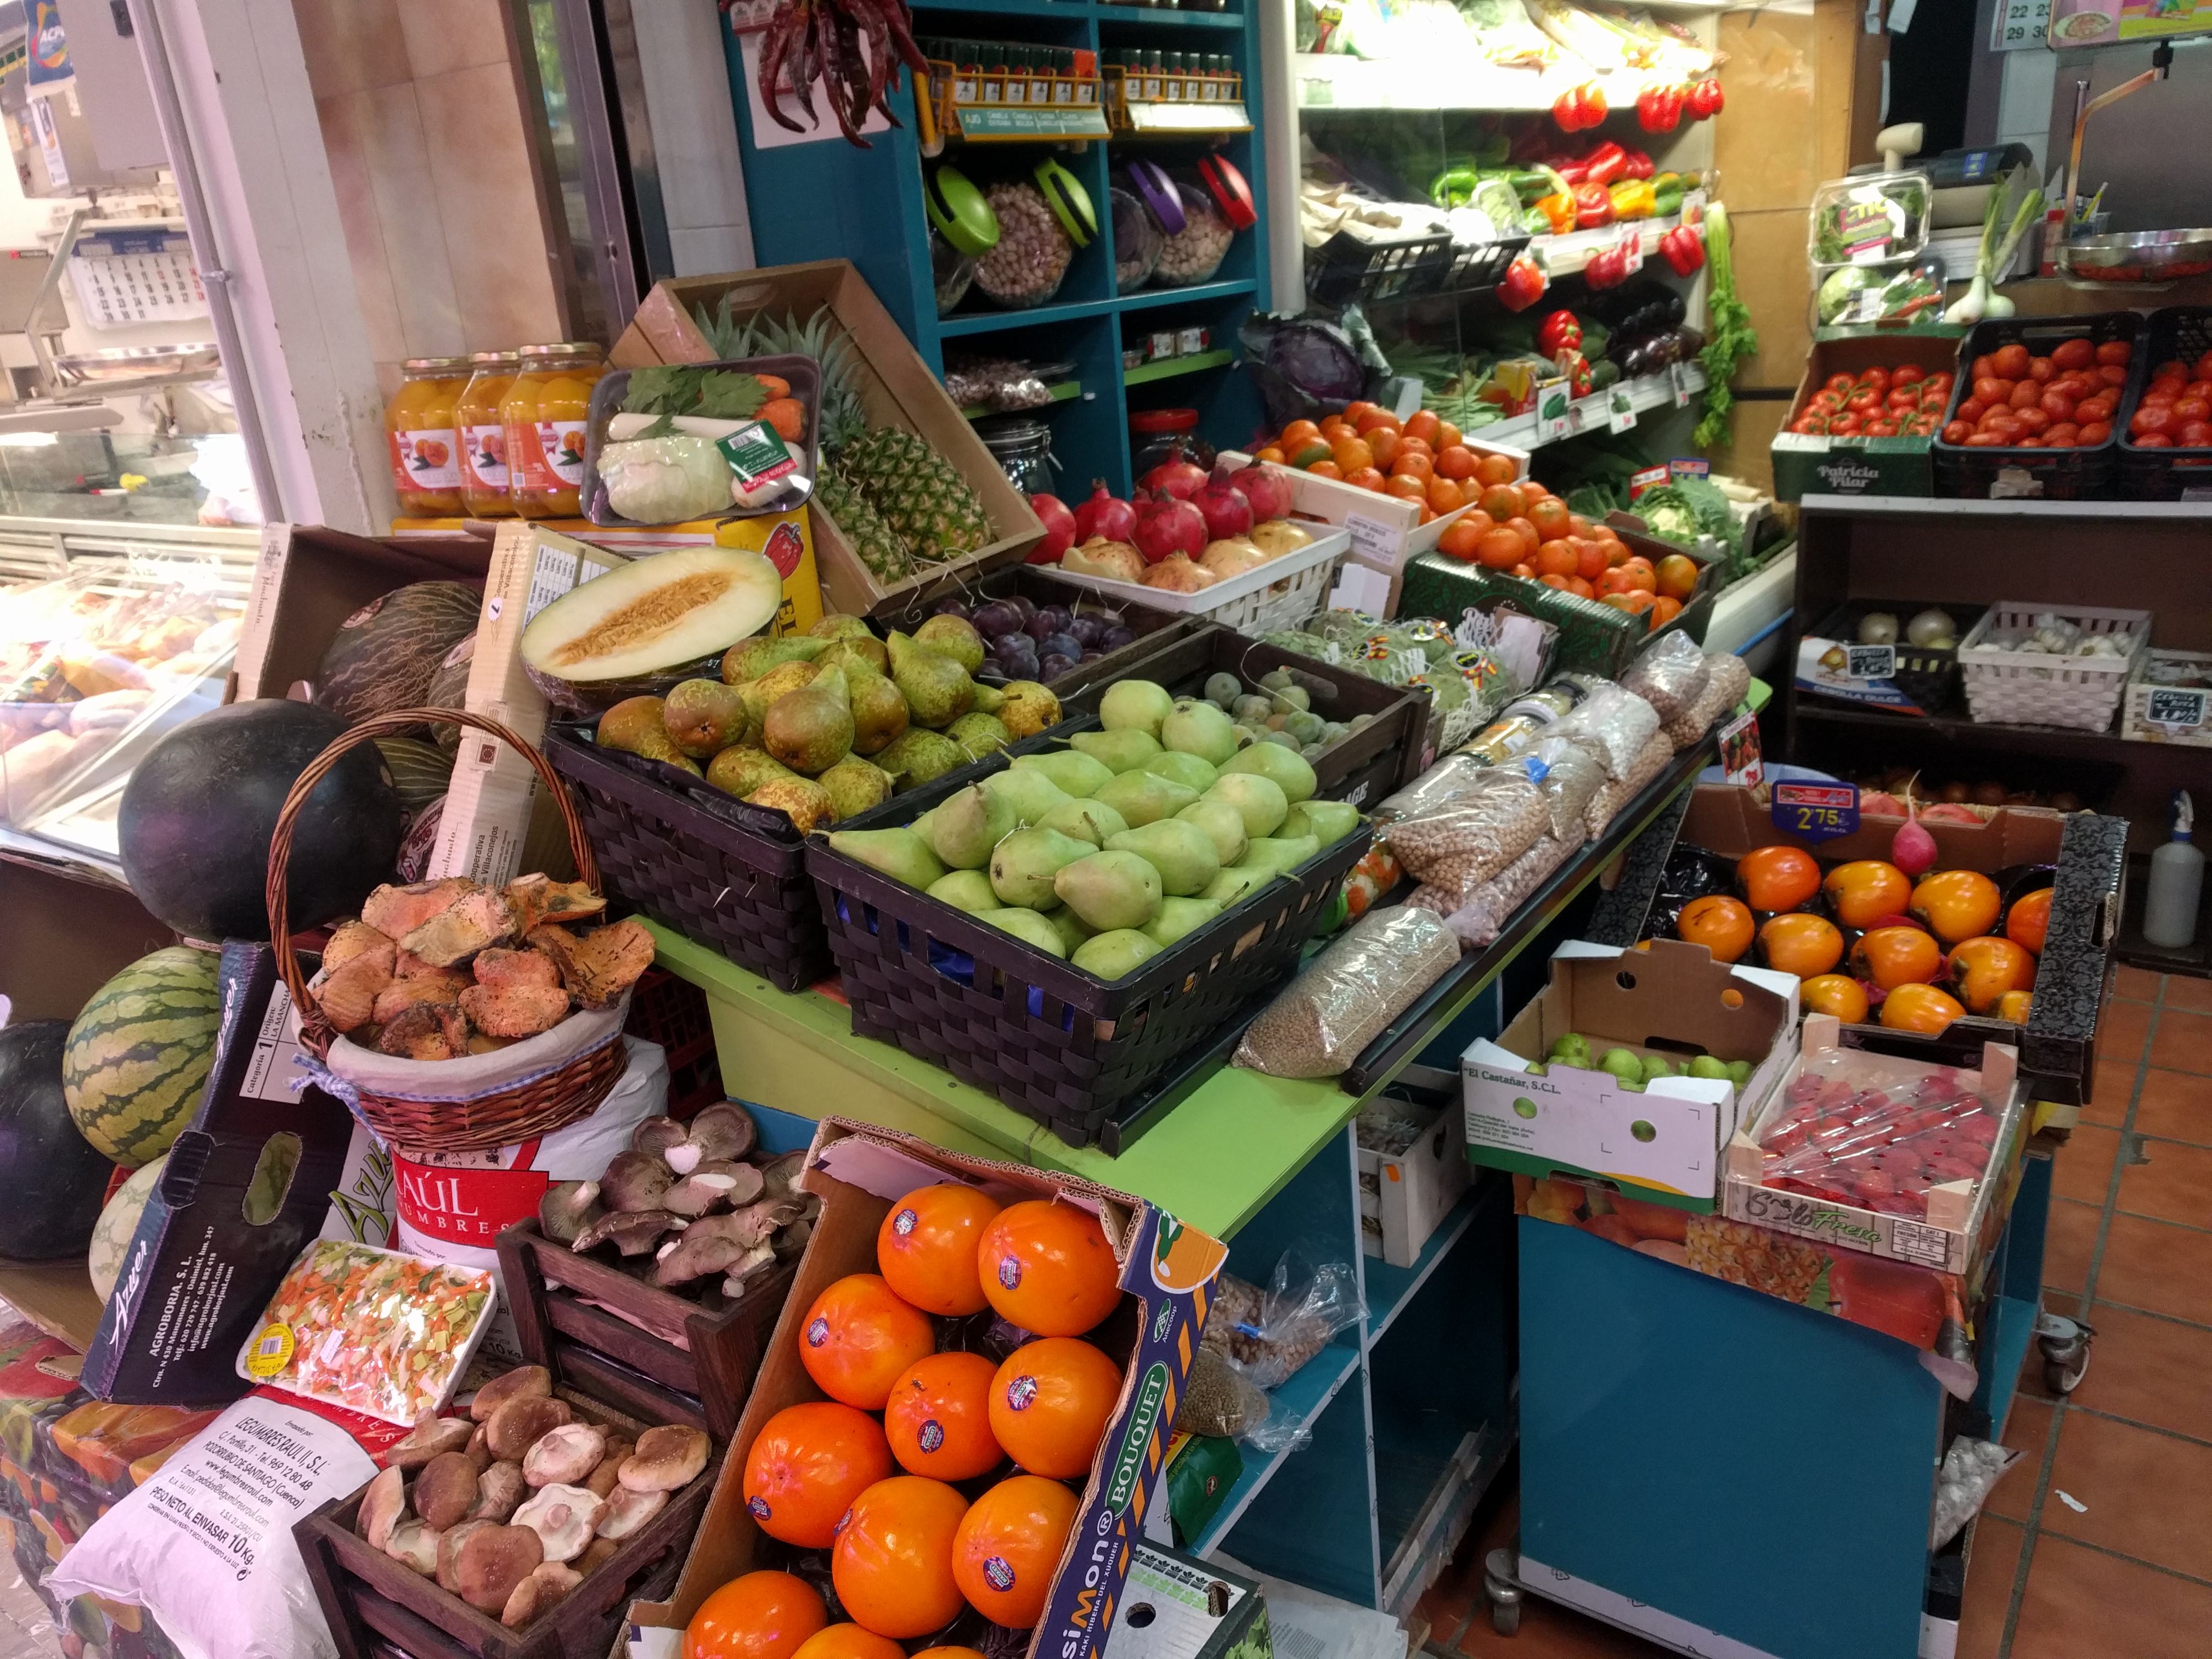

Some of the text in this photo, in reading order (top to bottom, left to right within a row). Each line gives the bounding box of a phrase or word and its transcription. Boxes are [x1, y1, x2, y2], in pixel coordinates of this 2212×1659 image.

[2006, 27, 2024, 40] 29
[2010, 5, 2028, 19] 22
[1817, 465, 1879, 478] Patricia
[262, 1007, 276, 1036] Origen:
[271, 989, 291, 1037] LA MANCHA
[247, 1042, 273, 1093] Categoría 1
[1482, 1070, 1528, 1090] Castañar,
[1531, 1081, 1561, 1094] S.C.L.
[395, 1172, 478, 1217] AÚL
[149, 1256, 192, 1357] AGROBORJA. S. L.
[153, 1367, 165, 1388] Ctra.
[163, 1345, 172, 1359] 430
[170, 1296, 191, 1344] Manzanares
[205, 1226, 215, 1239] 347
[180, 1328, 189, 1343] 620
[185, 1313, 195, 1327] 729
[190, 1299, 200, 1312] 747
[197, 1282, 206, 1295] 639
[202, 1267, 212, 1280] 882
[207, 1252, 217, 1266] 418
[187, 1262, 225, 1352] info@agroborjasl.com
[201, 1266, 234, 1349] www.agroborjasl.com
[1162, 1306, 1177, 1344] Anecoop
[235, 1417, 284, 1448] LEGUMBRES
[277, 1437, 302, 1460] RAUL
[285, 1420, 314, 1438] Envasado por:
[926, 1429, 935, 1446] BOUQUET
[1111, 1374, 1163, 1505] BOUQUET
[203, 1441, 305, 1510] POZORRUBIO DE SANTIAGO (Cuenca)
[205, 1460, 273, 1507] www.legumbresraul.com
[227, 1434, 246, 1452] Portillo,
[245, 1444, 256, 1454] 31
[257, 1452, 268, 1465] Tel.
[267, 1458, 284, 1471] 969
[281, 1466, 292, 1477] 12
[289, 1470, 302, 1484] 80
[300, 1477, 313, 1491] 48
[195, 1474, 269, 1528] pedidos@legumbresraul.com
[150, 1486, 255, 1565] PESO NETO AL ENVASAR 10 Kg.
[992, 1565, 1007, 1583] BOUQUET
[1079, 1542, 1119, 1657] KAKI RIBERA DEL XÚQUER
